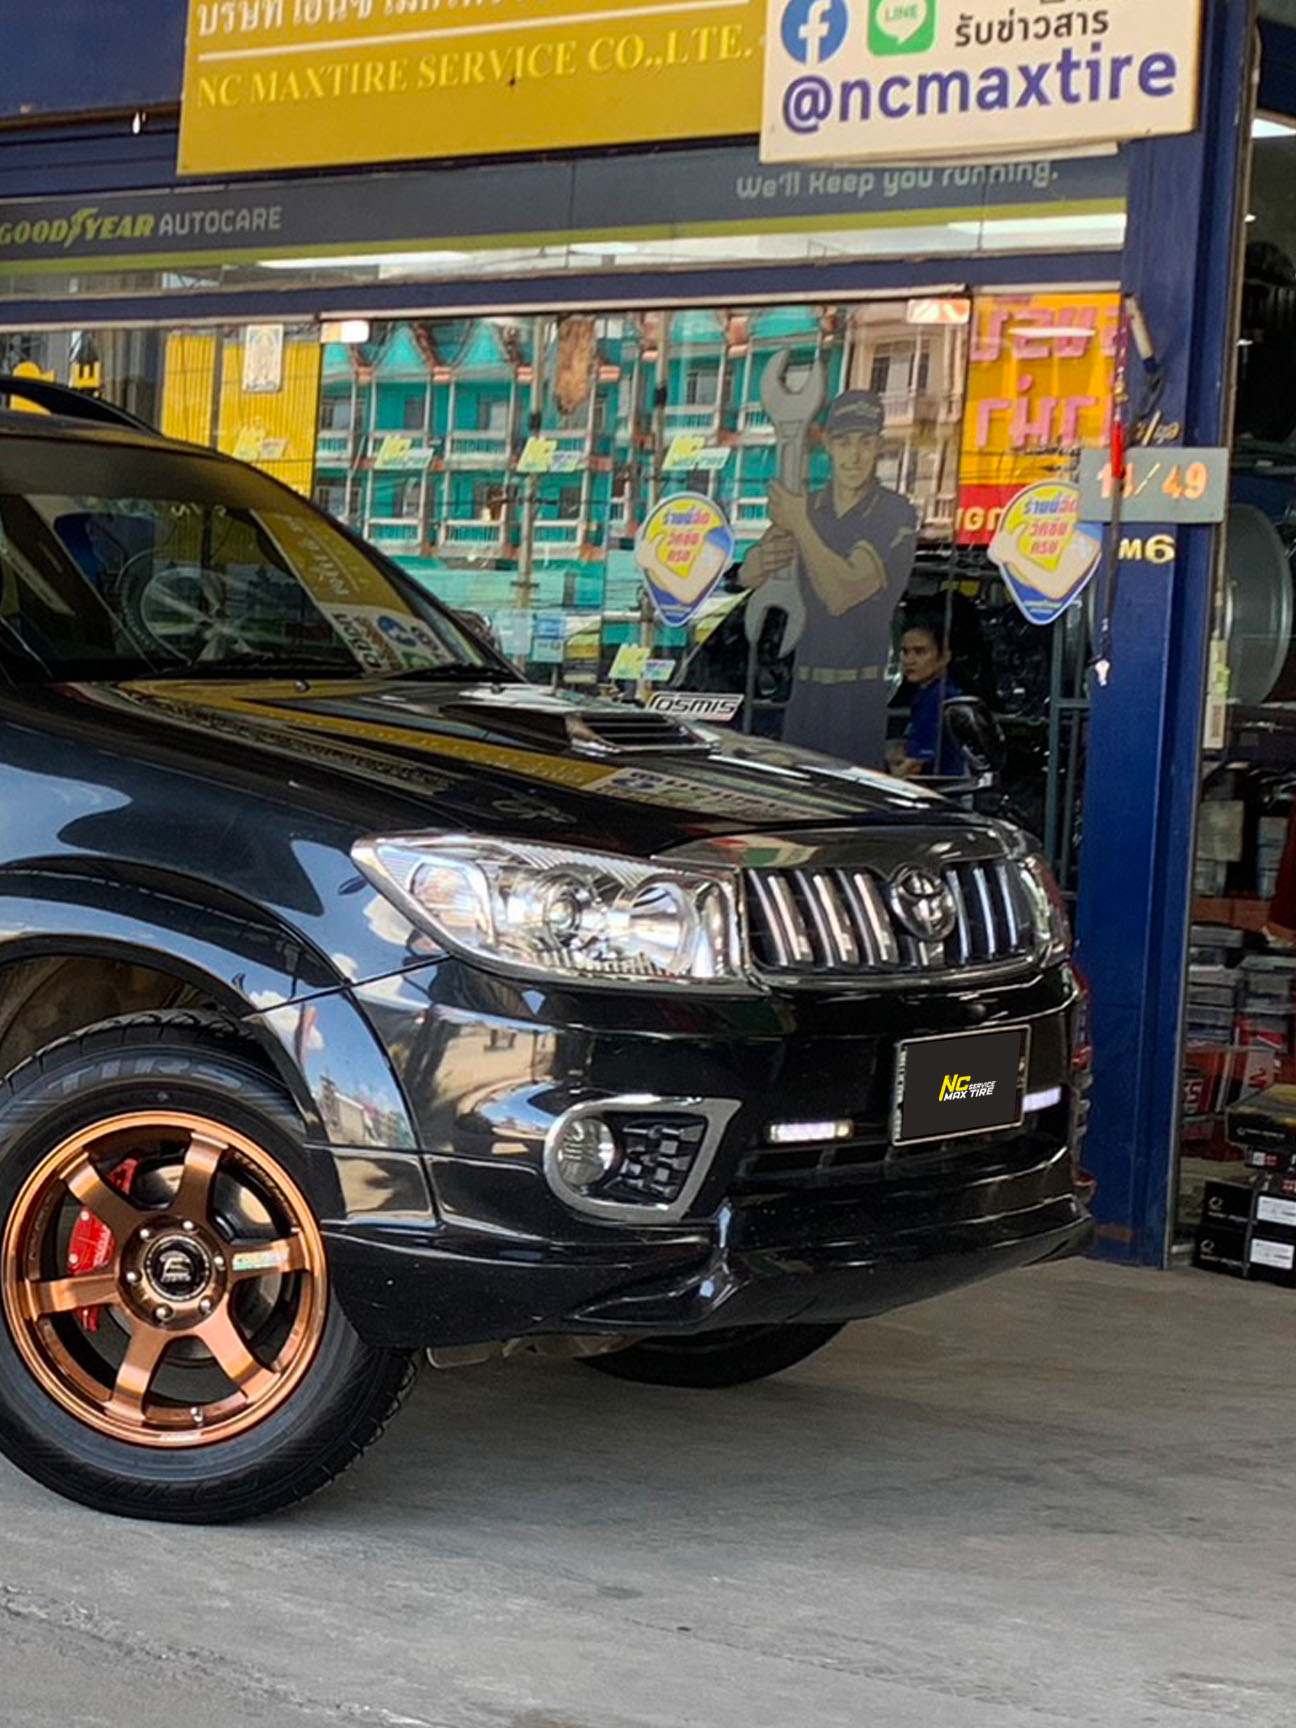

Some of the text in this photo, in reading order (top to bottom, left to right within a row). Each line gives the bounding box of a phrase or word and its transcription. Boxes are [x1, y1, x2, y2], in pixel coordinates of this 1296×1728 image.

[954, 9, 1109, 48] รับข่าวสาร
[199, 74, 242, 107] NC
[251, 58, 407, 103] MAXTIRE
[418, 40, 576, 89] SERVICE
[782, 42, 1176, 134] @ncmaxtire
[735, 171, 800, 200] We'll
[882, 170, 933, 197] you
[159, 206, 282, 237] AUTOCARE
[1118, 533, 1175, 564] M6
